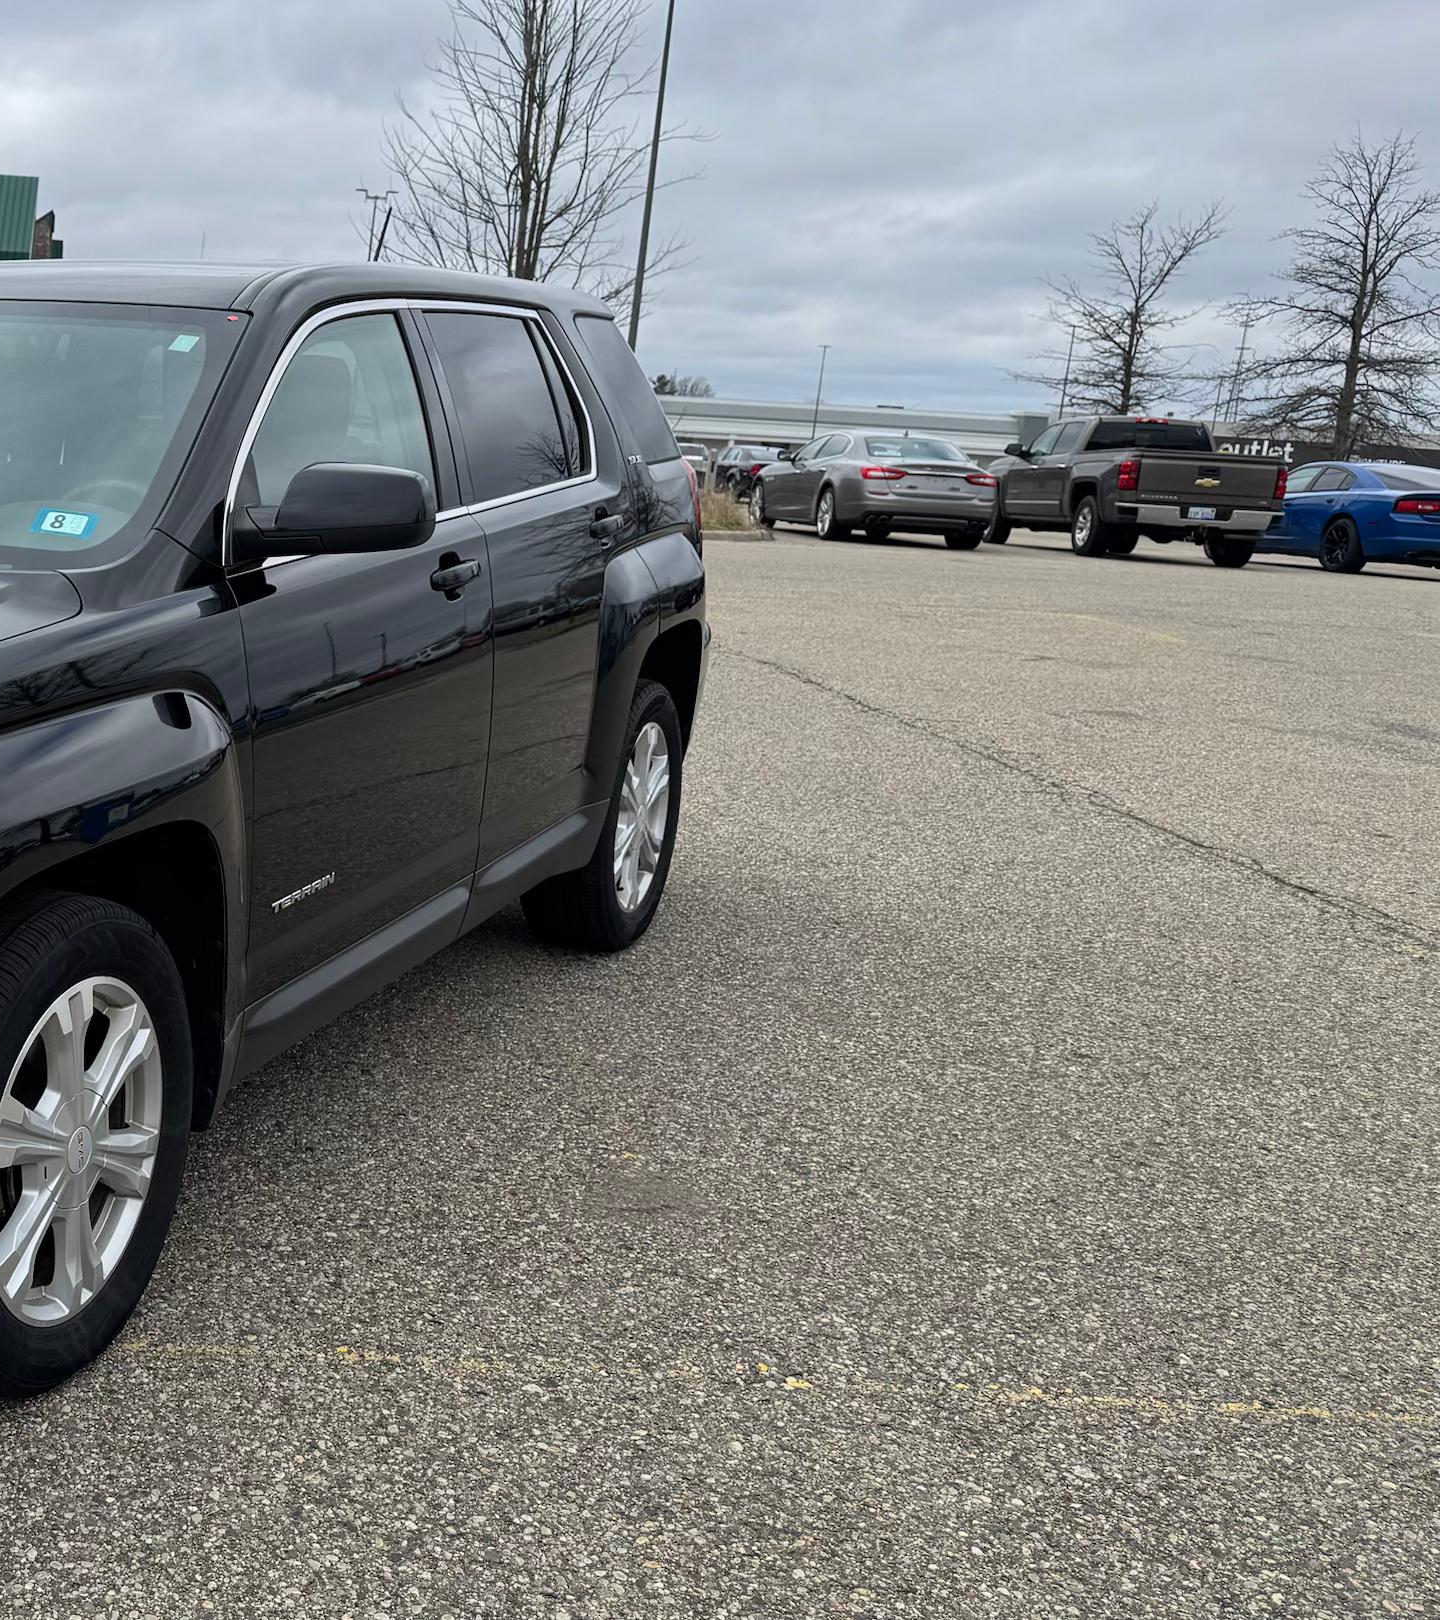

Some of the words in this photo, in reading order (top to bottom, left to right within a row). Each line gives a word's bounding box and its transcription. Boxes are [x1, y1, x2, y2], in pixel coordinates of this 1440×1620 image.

[1216, 440, 1294, 463] outlet
[50, 515, 66, 529] 8
[271, 872, 336, 914] TERRAIN
